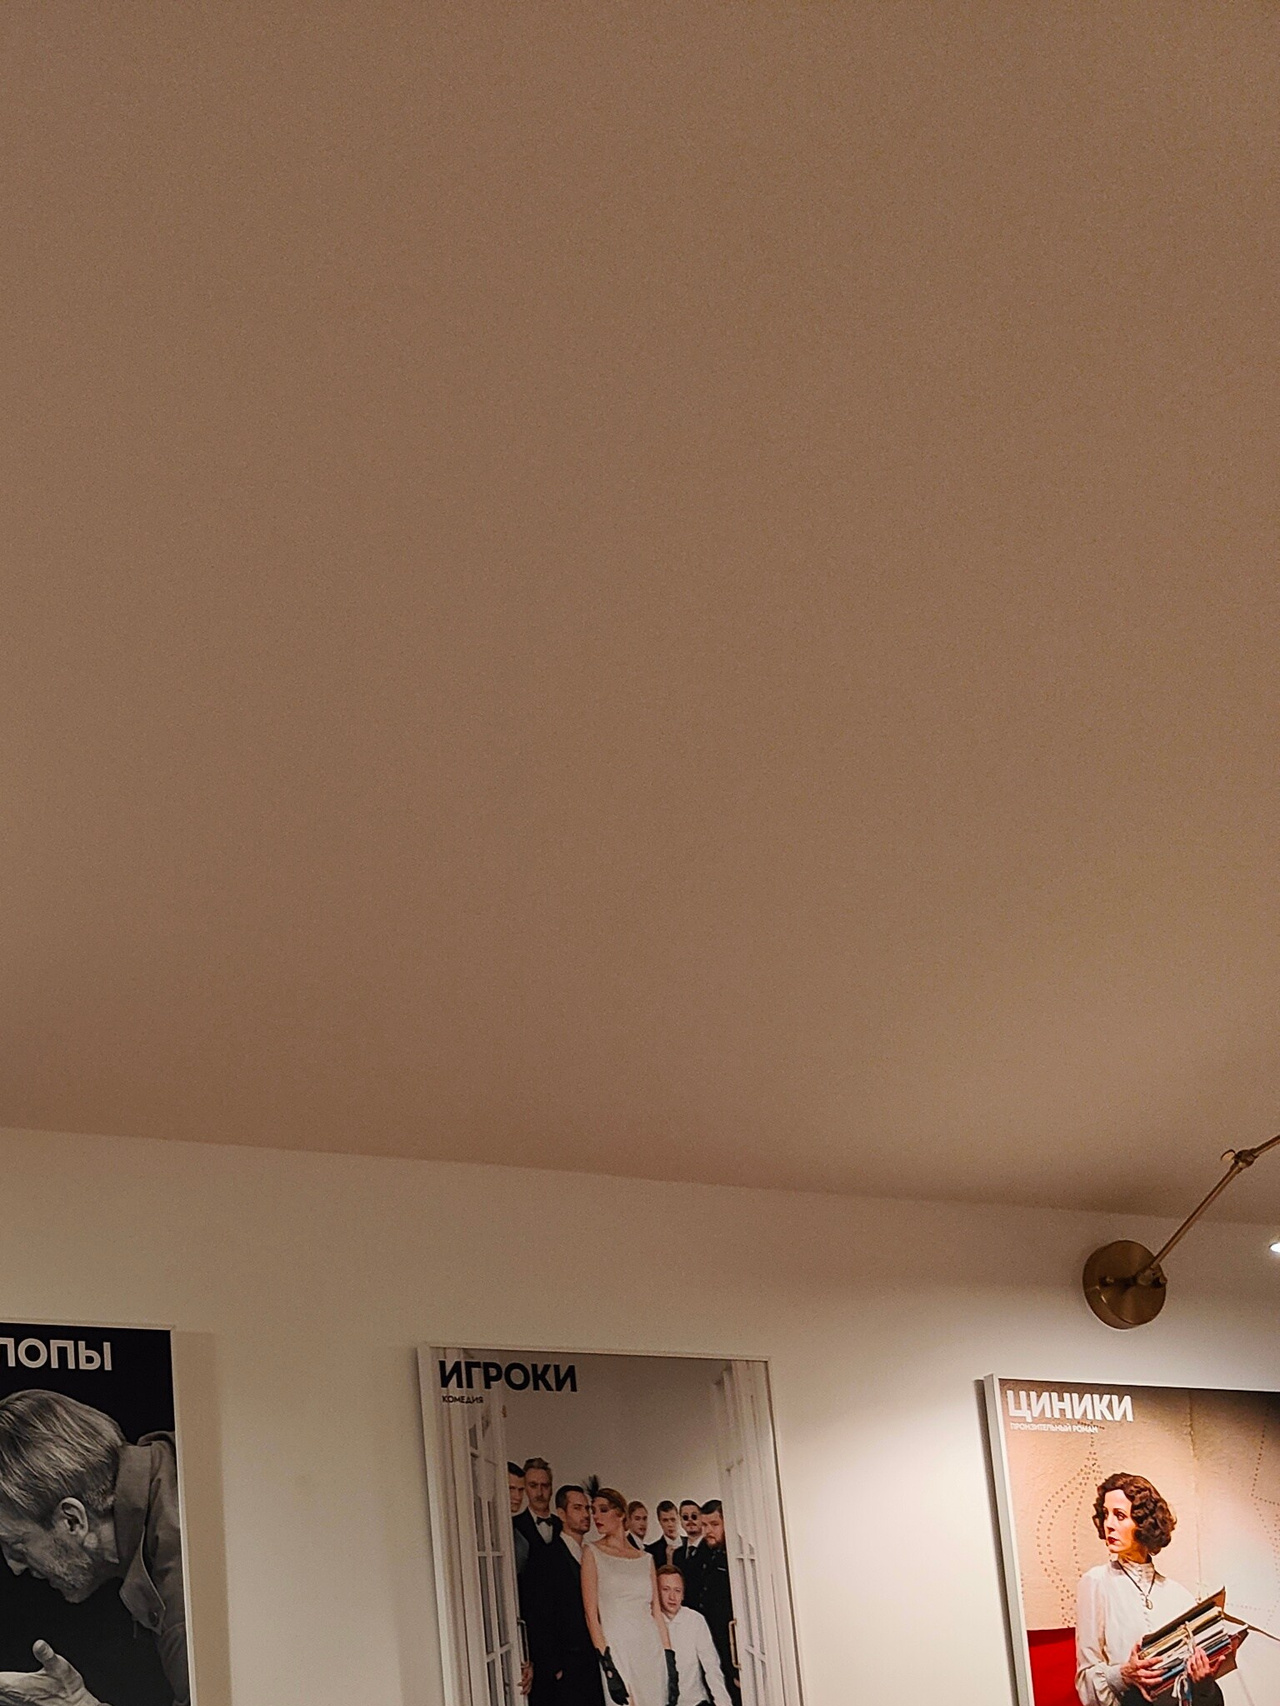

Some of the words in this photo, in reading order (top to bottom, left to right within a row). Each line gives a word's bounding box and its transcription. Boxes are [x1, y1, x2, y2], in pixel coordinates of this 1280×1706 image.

[439, 1360, 578, 1392] ИГРОКИ
[442, 1395, 484, 1404] КОМЕДИЯ
[1006, 1390, 1134, 1422] ЦИНИКИ
[1073, 1425, 1099, 1434] РОМАН
